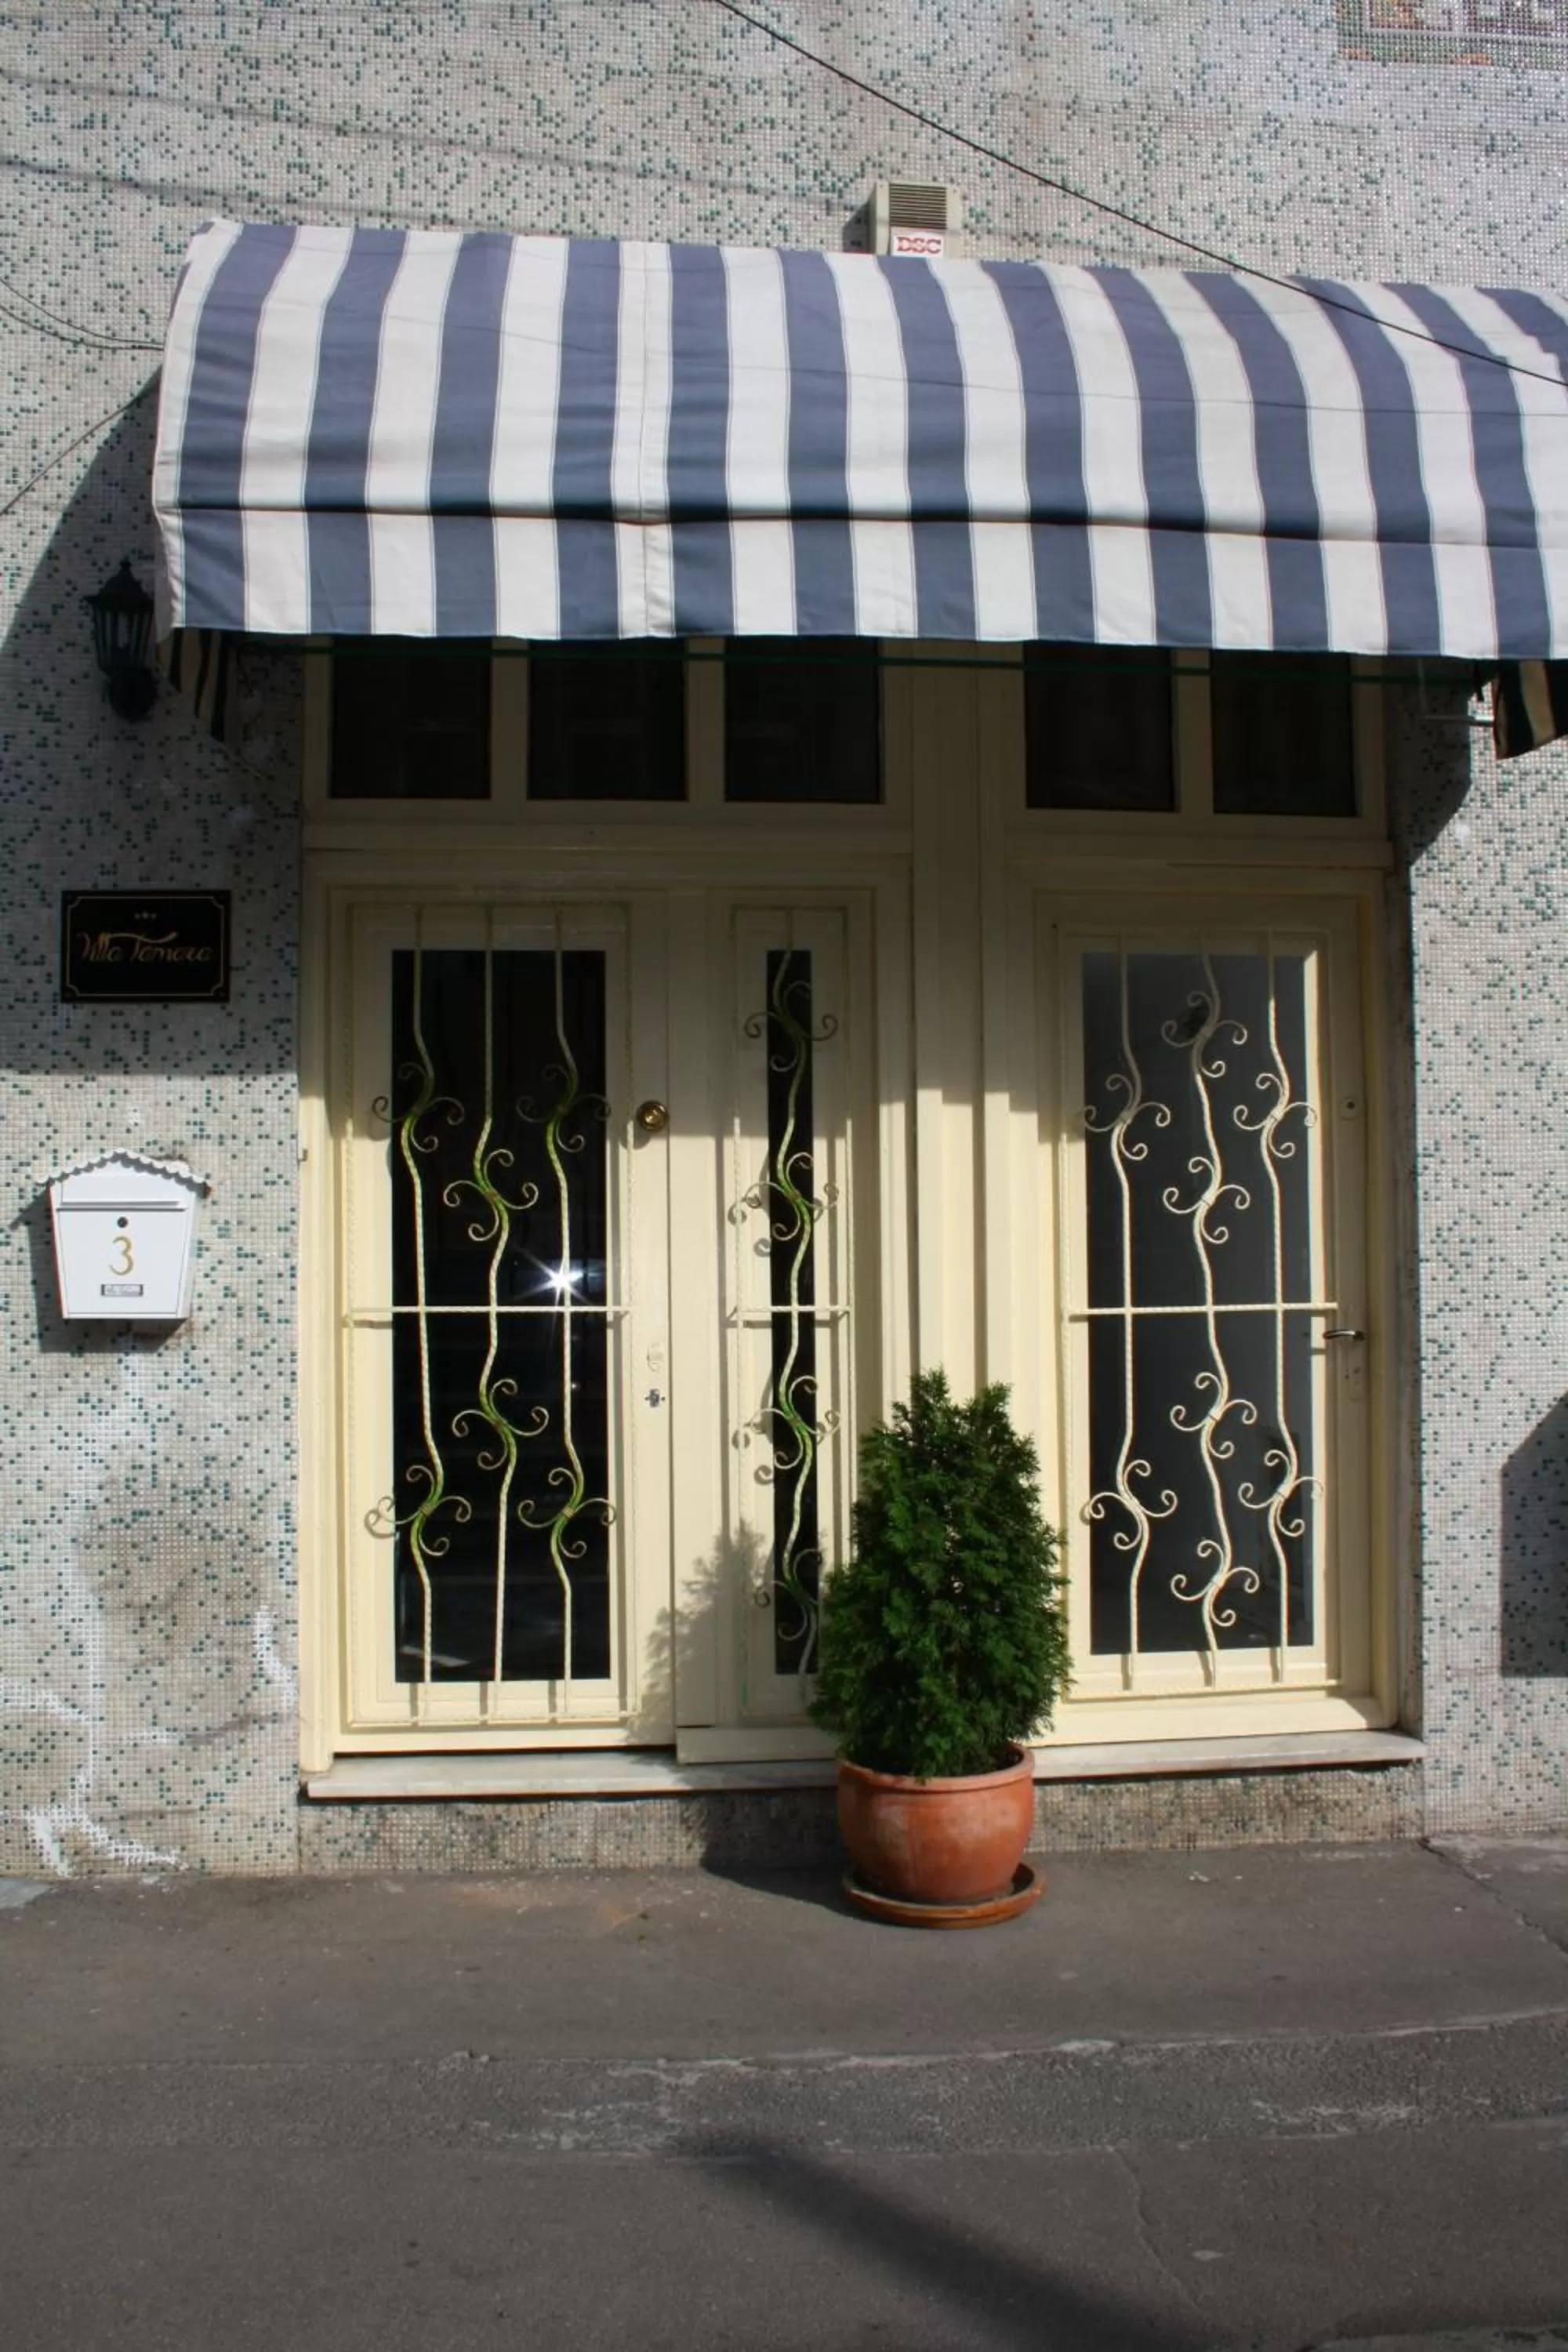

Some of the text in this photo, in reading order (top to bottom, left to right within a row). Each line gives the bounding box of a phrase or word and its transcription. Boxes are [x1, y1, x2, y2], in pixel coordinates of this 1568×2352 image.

[897, 236, 942, 254] DSC
[77, 931, 124, 962] Villa
[108, 1236, 134, 1276] 3
